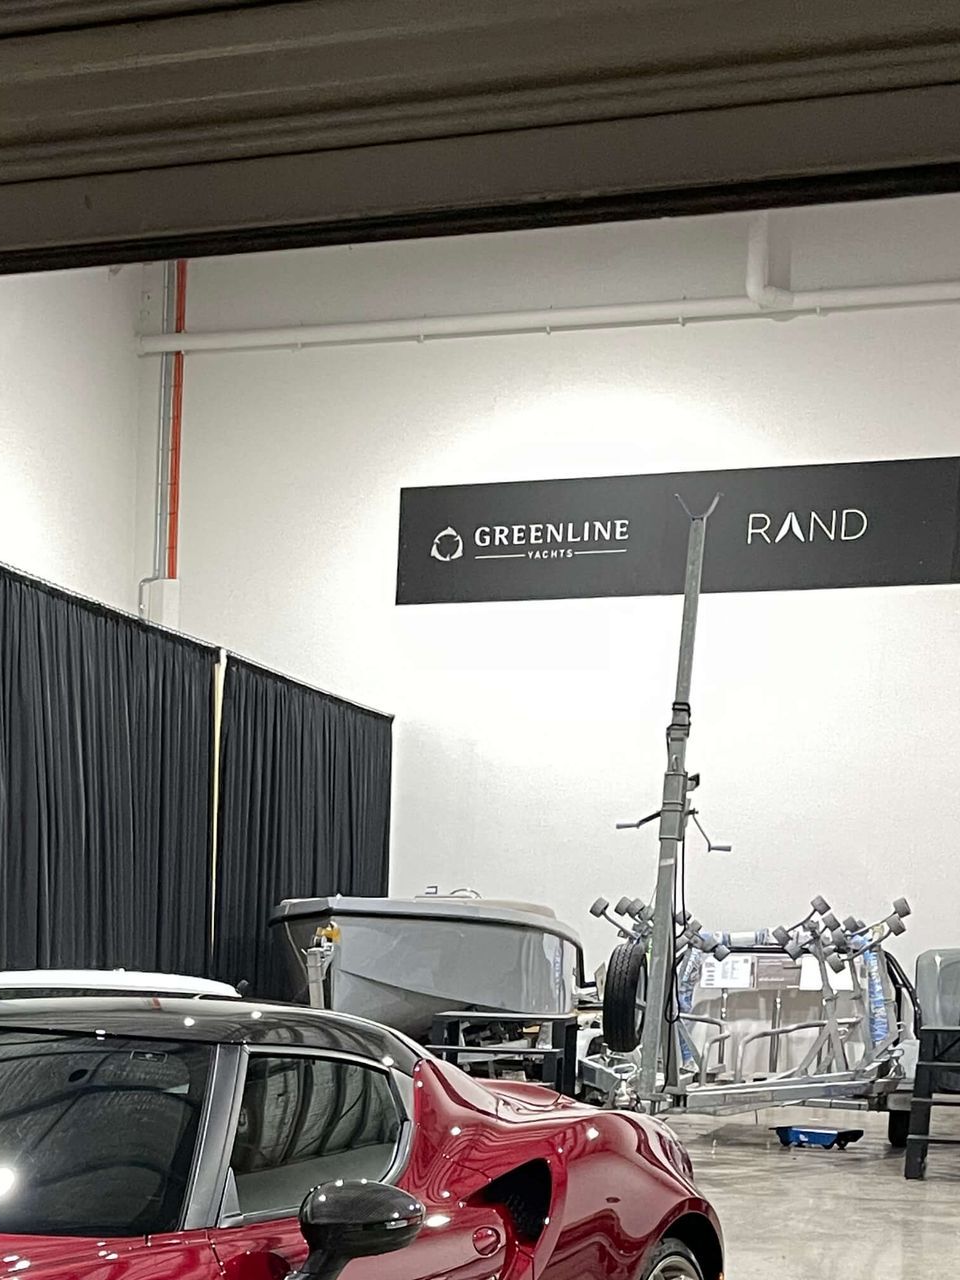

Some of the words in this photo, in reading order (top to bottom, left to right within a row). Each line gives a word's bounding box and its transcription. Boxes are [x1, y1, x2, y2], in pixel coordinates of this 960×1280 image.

[474, 519, 630, 547] GREENLINE
[746, 509, 868, 545] RAND
[527, 549, 574, 560] YACHTS
